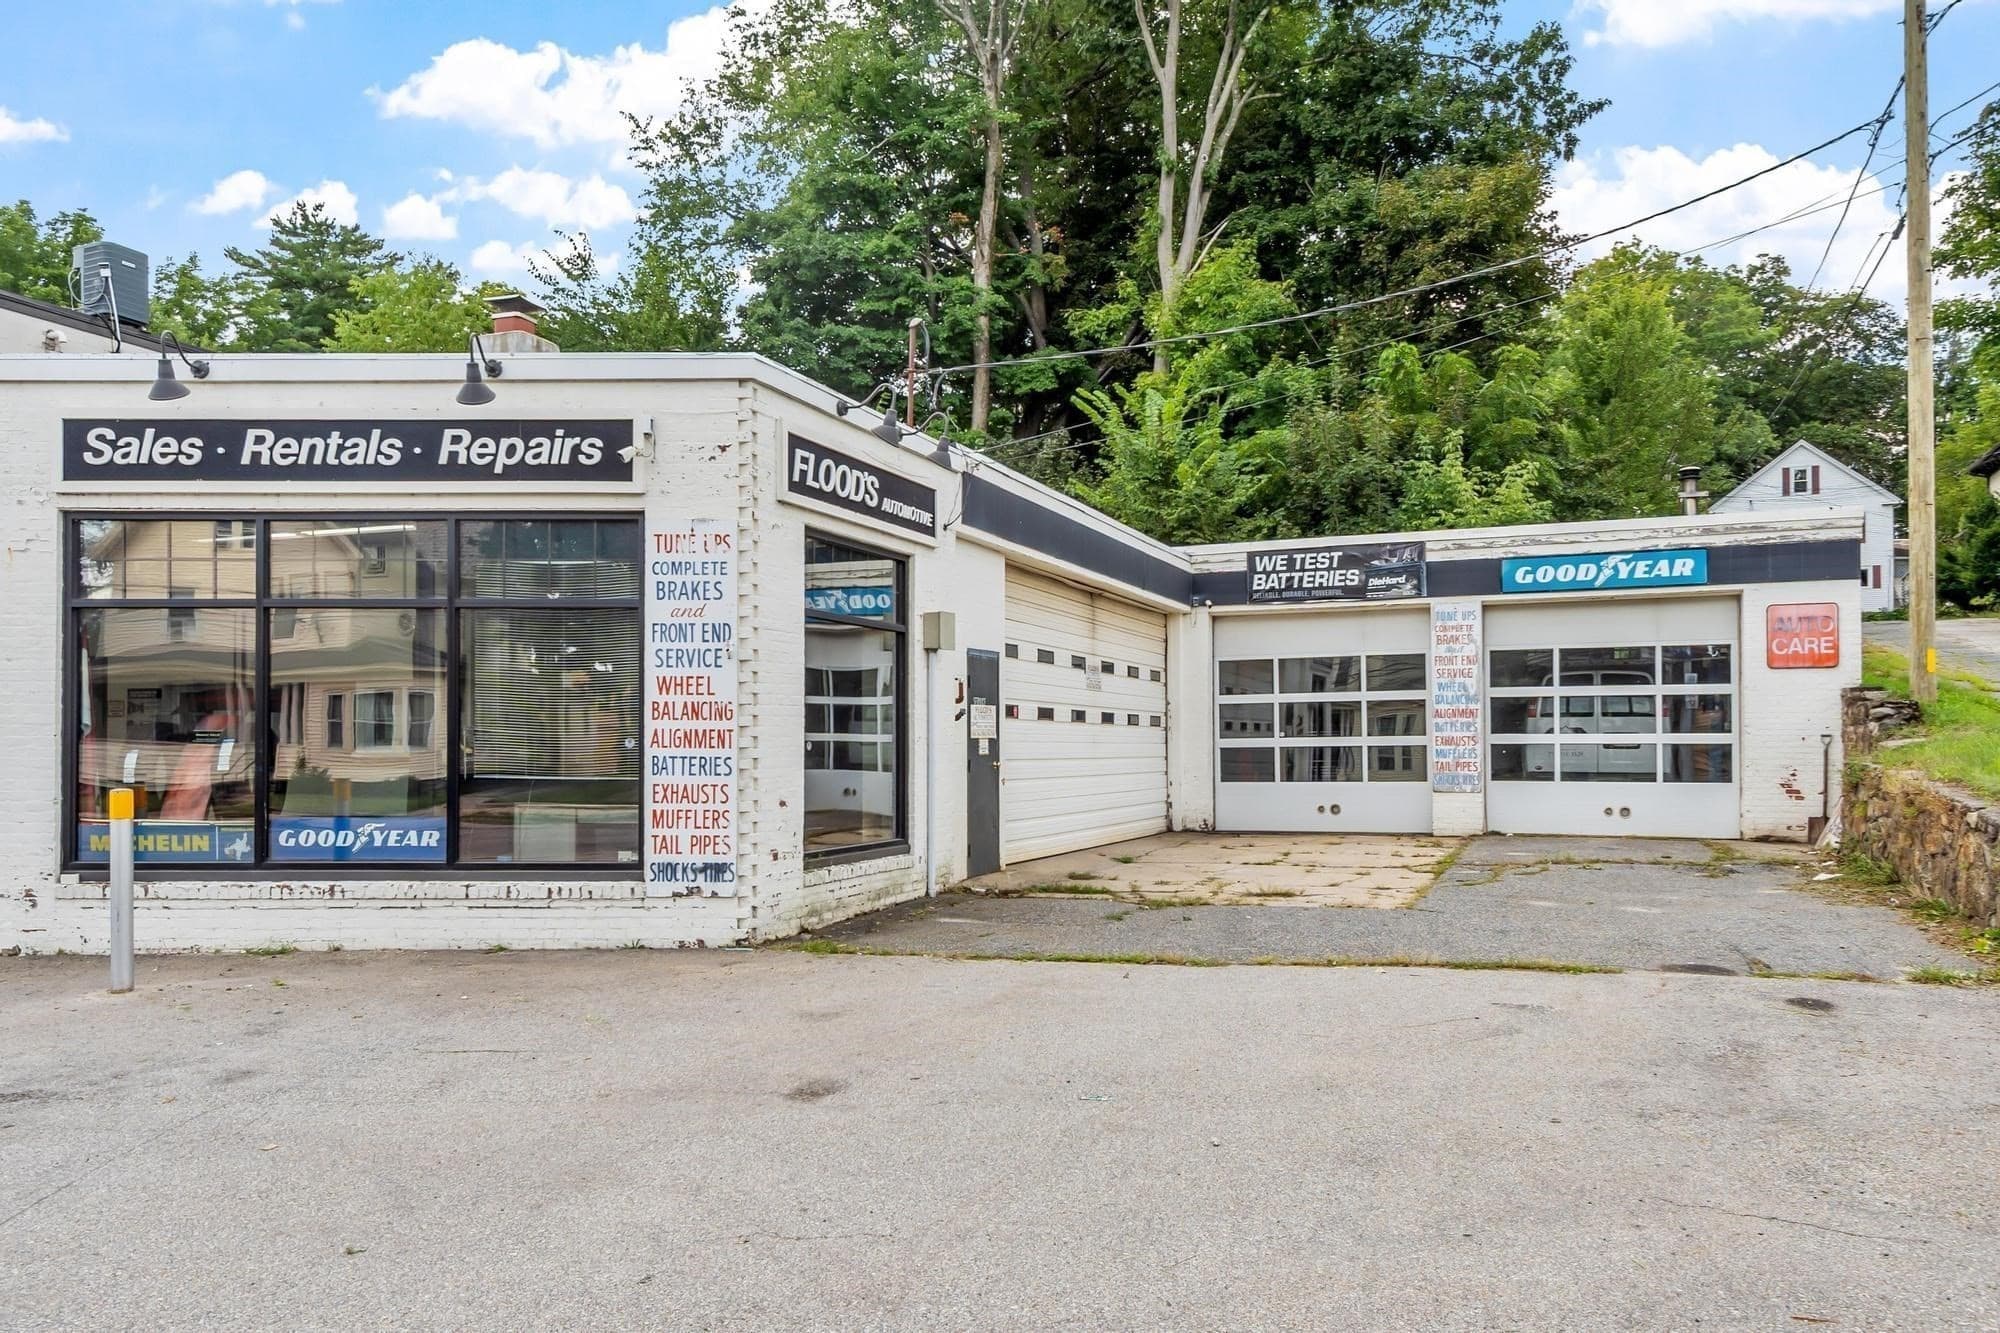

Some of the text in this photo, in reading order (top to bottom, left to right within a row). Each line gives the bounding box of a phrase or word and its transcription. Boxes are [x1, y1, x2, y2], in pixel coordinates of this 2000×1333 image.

[83, 428, 604, 474] Sales Rentals Repairs
[792, 448, 933, 527] FLOOD'S AUTOMOTIVE
[652, 561, 728, 576] COMPLETE
[1255, 551, 1343, 572] WE TEST
[1252, 569, 1360, 591] BATTERIES
[1367, 575, 1406, 587] DieHard
[656, 581, 724, 601] BRAKES
[670, 603, 707, 618] and
[652, 623, 732, 643] FRONT END
[1772, 636, 1835, 655] CARE
[655, 648, 723, 668] SERVICE
[1435, 668, 1473, 679] SERVICE
[656, 676, 716, 696] WHEEL
[651, 701, 733, 721] BALANCING
[1434, 708, 1479, 719] ALIGNMENT
[650, 728, 734, 749] ALIGNMENT
[1435, 736, 1478, 747] EXHAUSTS
[651, 755, 732, 776] BATTERIES
[1435, 761, 1479, 772] TAIL PIPES
[652, 784, 729, 804] EXHAUSTS
[652, 809, 730, 830] MUFFLERS
[89, 834, 209, 852] MHELIN
[651, 834, 731, 855] TAIL PIPES
[649, 862, 698, 882] SHOCKS
